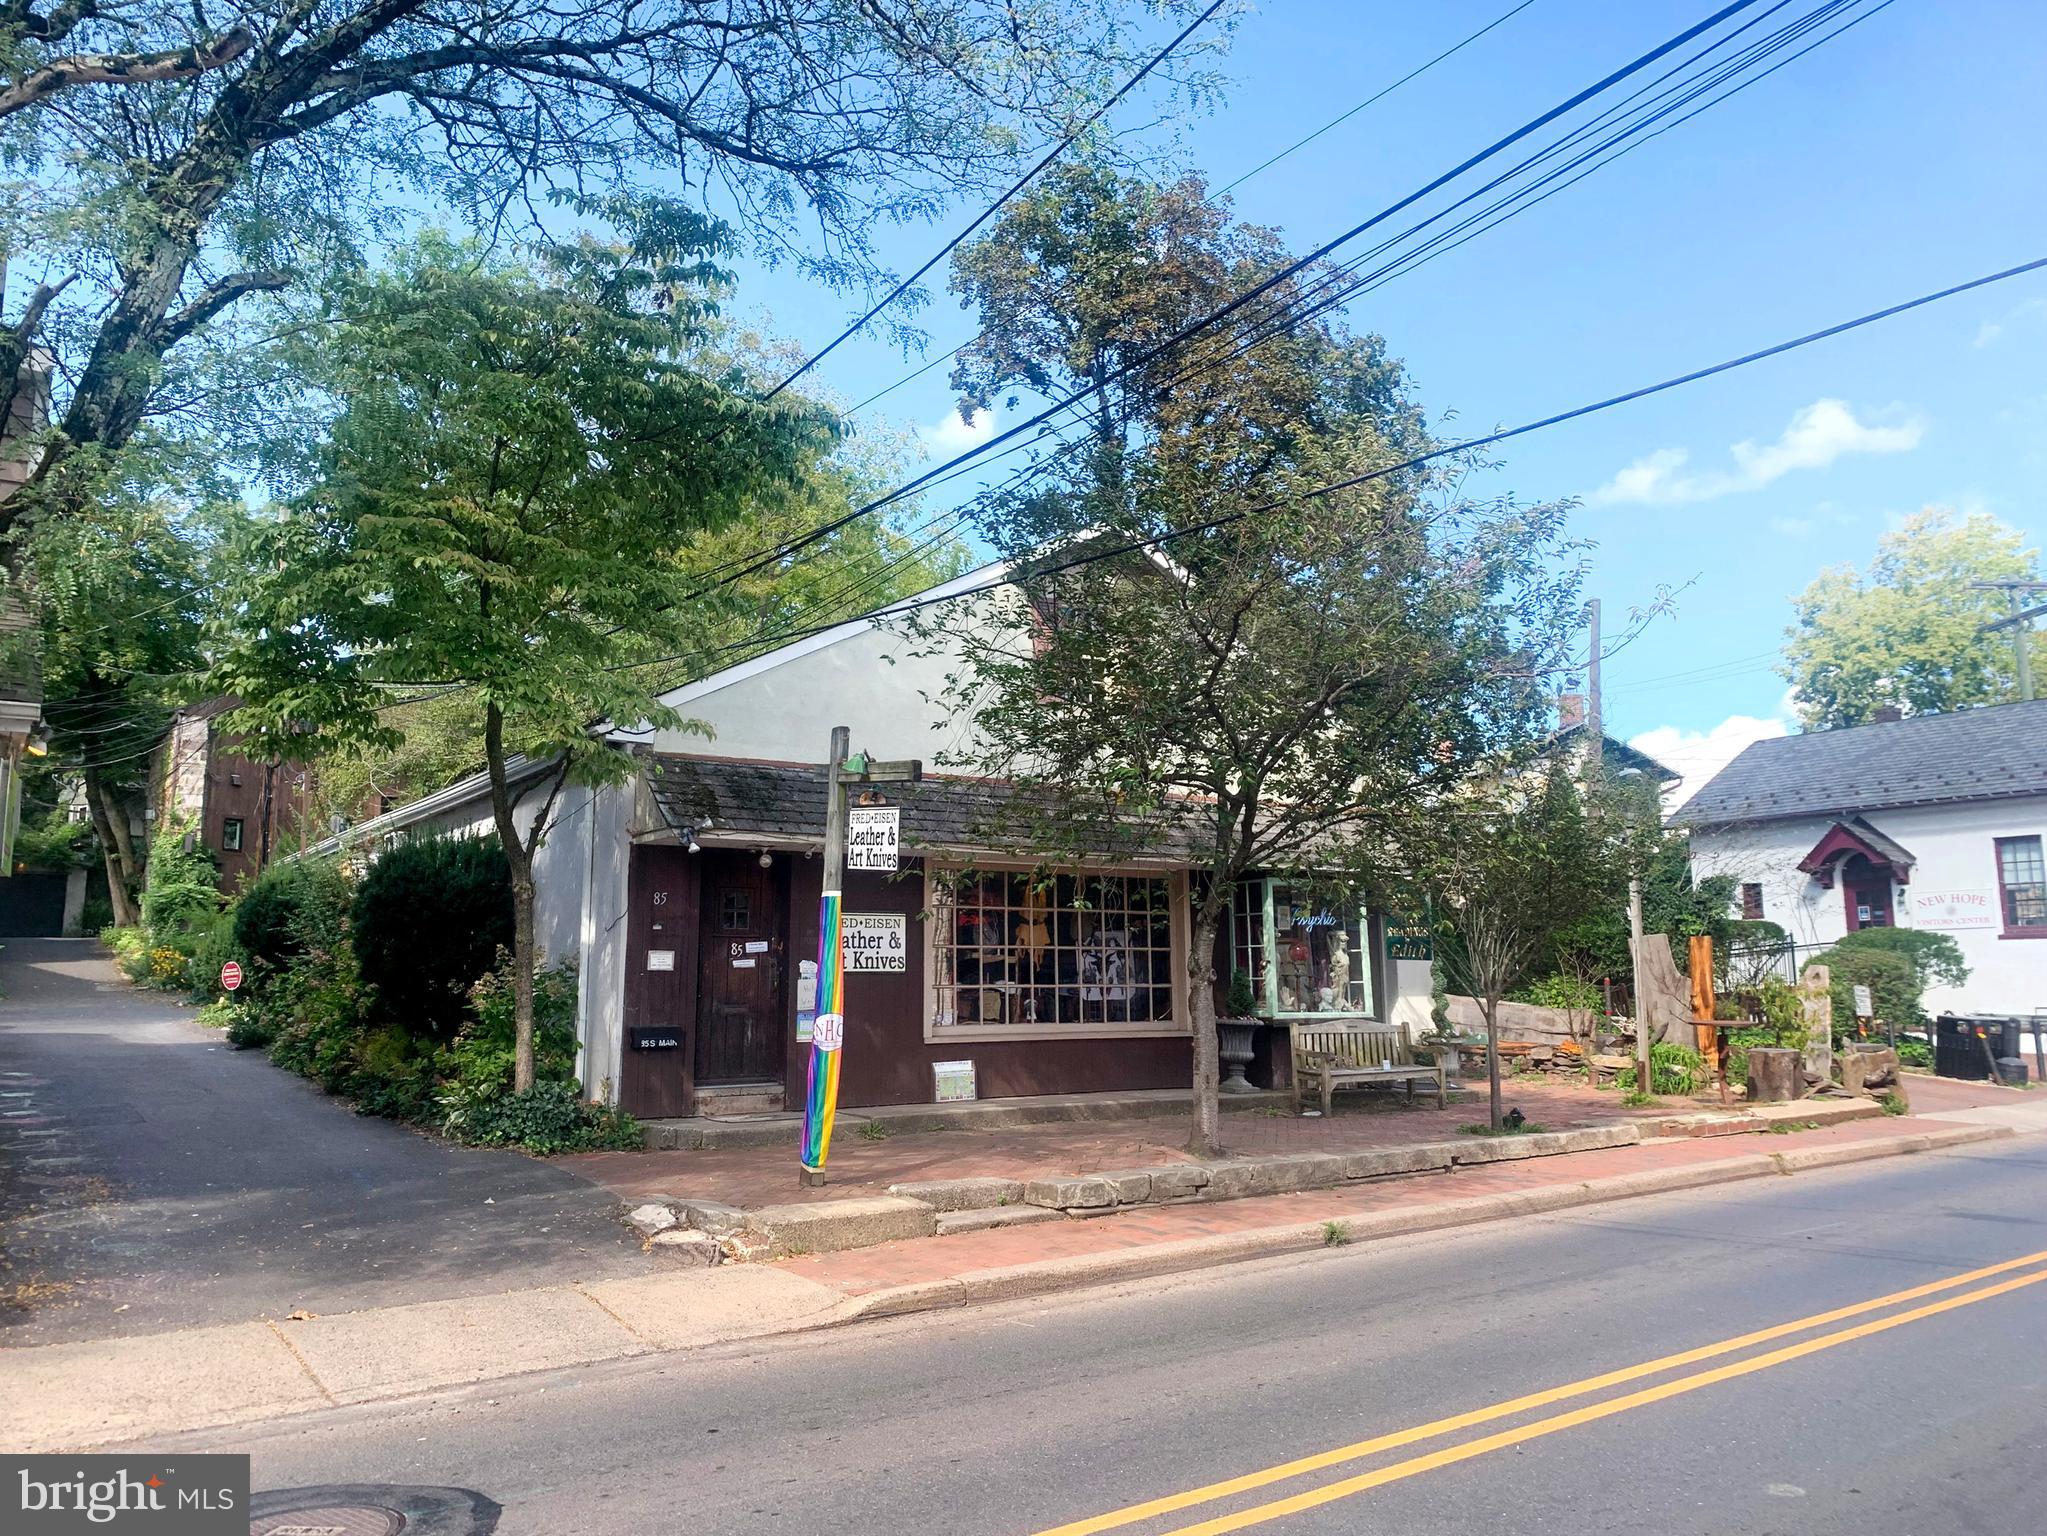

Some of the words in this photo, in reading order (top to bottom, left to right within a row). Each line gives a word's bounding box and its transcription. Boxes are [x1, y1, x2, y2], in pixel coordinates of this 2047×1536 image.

[850, 826, 885, 846] Leather
[887, 826, 896, 846] &
[848, 847, 863, 867] Art
[866, 847, 897, 868] Knives
[653, 891, 668, 905] 85
[1917, 895, 1946, 908] NEW
[1951, 893, 1986, 906] HOPE
[889, 931, 902, 949] &
[731, 943, 743, 957] 85
[852, 951, 905, 970] Knives
